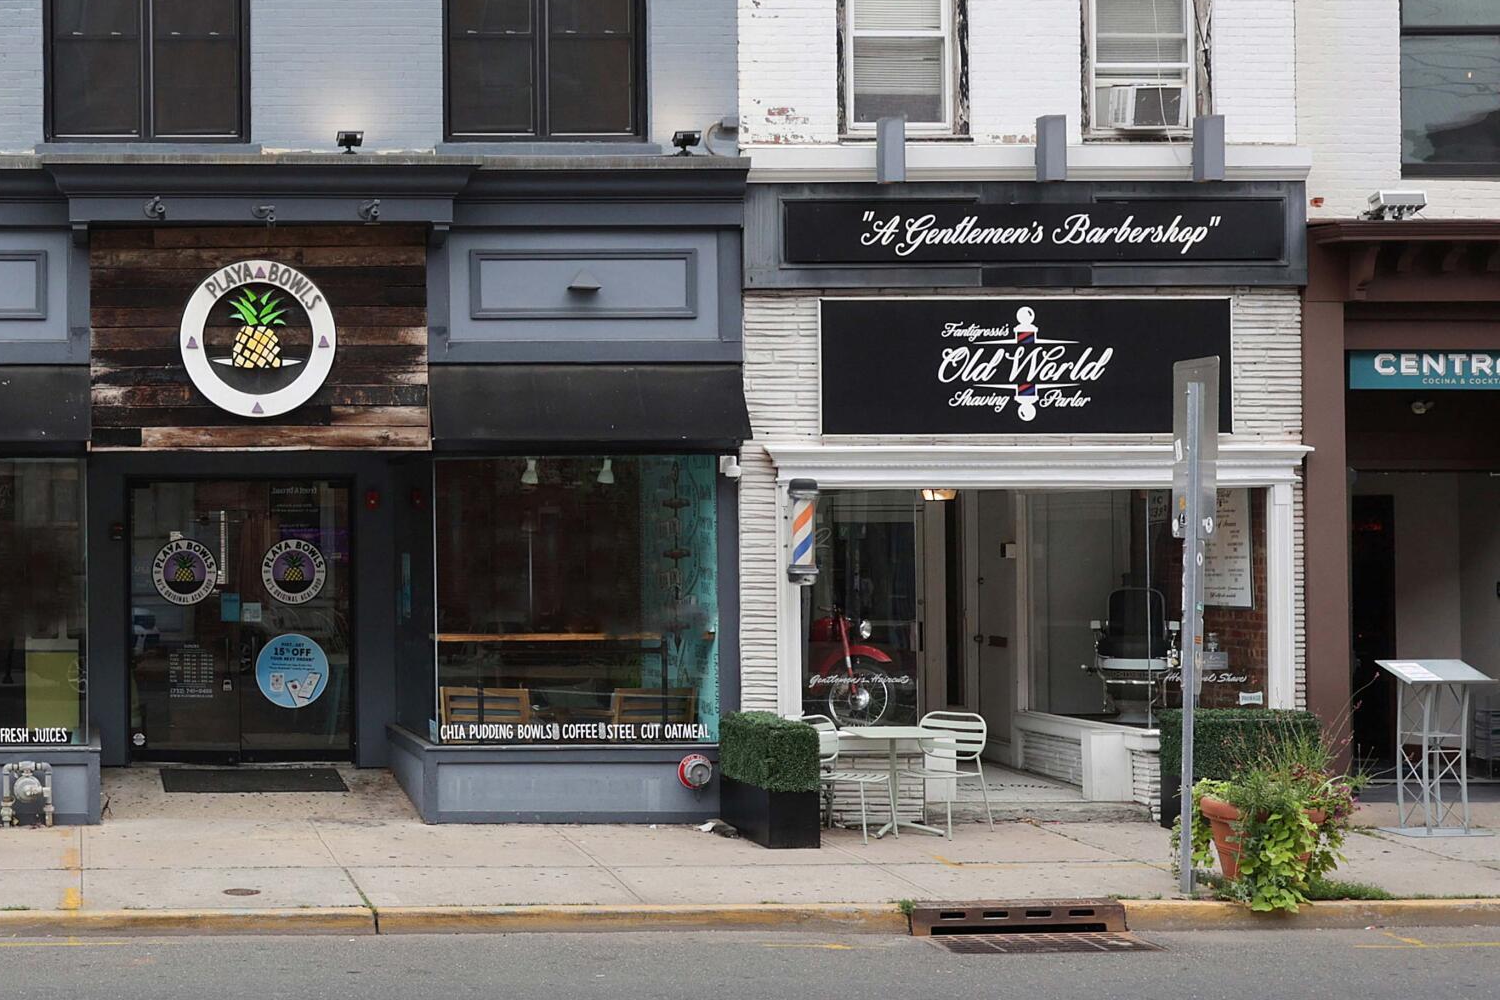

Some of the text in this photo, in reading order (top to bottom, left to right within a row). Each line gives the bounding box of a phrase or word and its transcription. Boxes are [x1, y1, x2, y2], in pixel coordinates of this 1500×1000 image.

[895, 213, 1044, 257] Gentlemen's
[203, 261, 323, 311] PLAYA BOWLS
[941, 321, 1010, 342] Fantigrossi's
[937, 345, 1114, 383] Old World
[1373, 352, 1500, 377] CENTR
[1422, 377, 1457, 385] COCINA
[948, 388, 1091, 413] Shaving Parlor
[155, 541, 214, 569] PLAYA BOWLS
[264, 541, 323, 568] PLAYA BOWLS
[291, 648, 312, 657] OFF
[0, 727, 29, 743] FRESH
[32, 727, 68, 743] JUICES
[440, 723, 711, 740] CHIA PUDDING BOWLS COFFEE STEEL CUT OATMEAL
